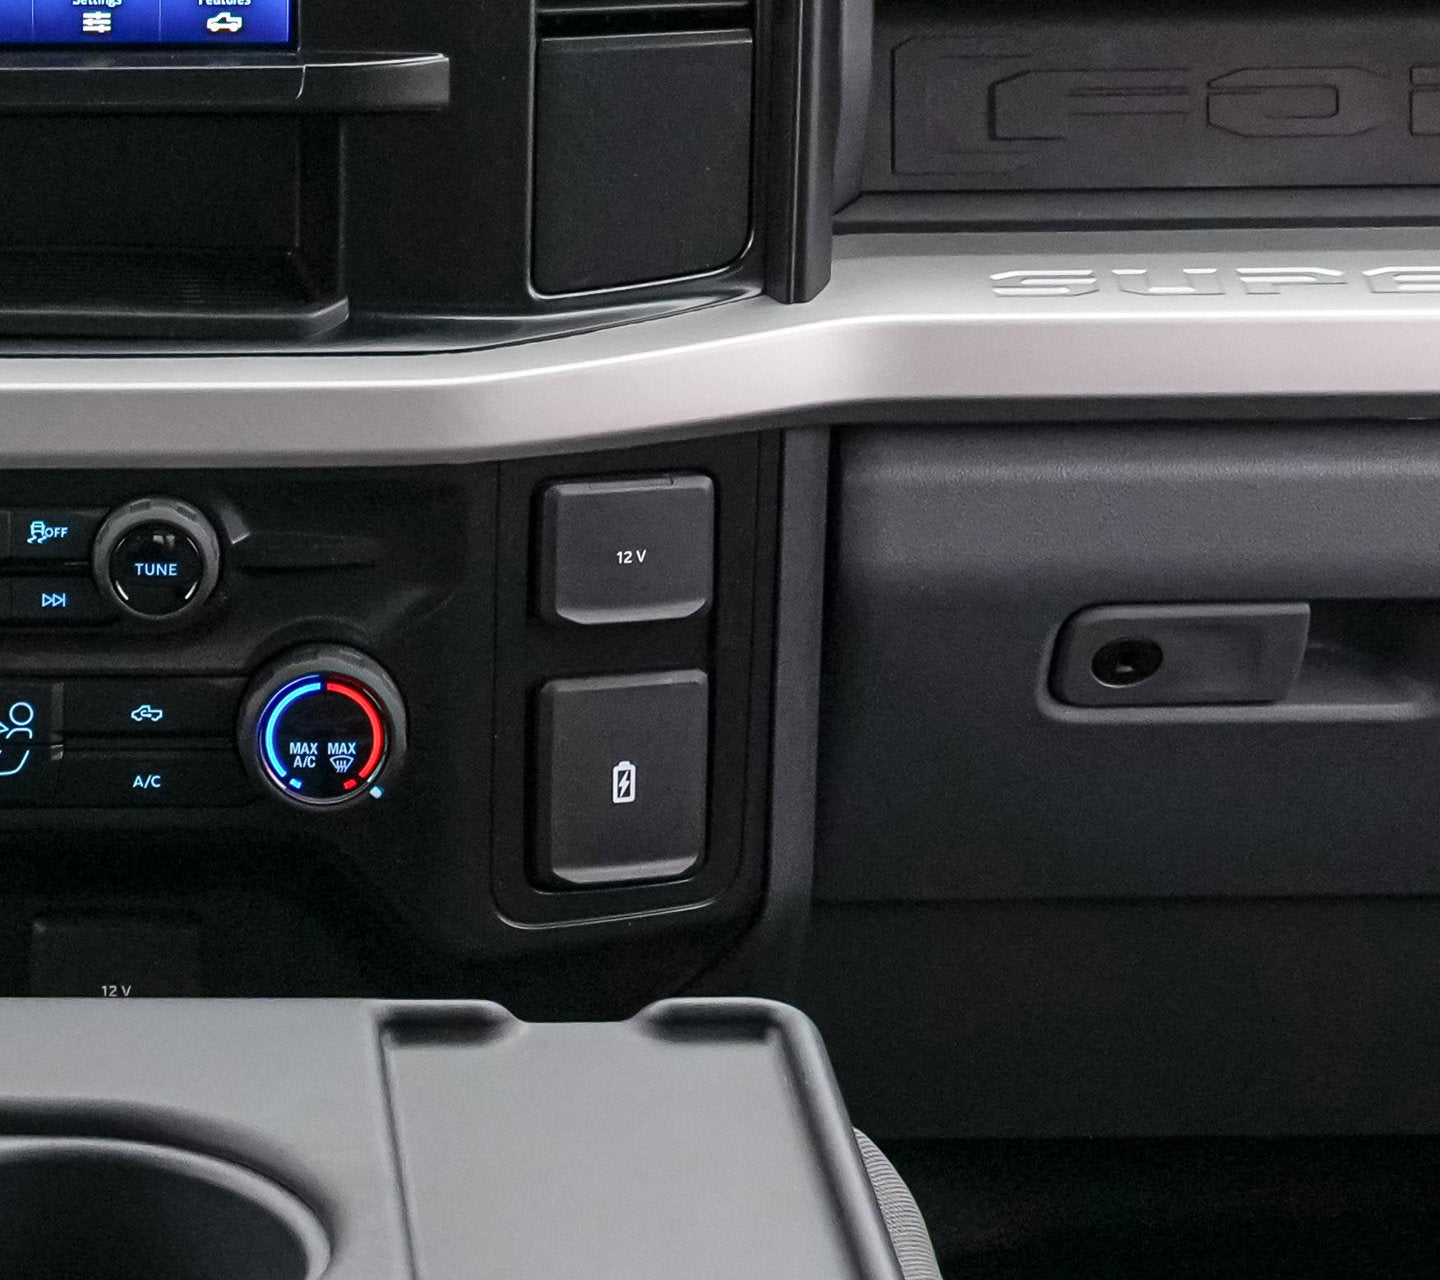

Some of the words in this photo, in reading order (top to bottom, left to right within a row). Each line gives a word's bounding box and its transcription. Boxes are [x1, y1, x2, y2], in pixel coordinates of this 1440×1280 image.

[44, 525, 68, 538] OFF
[616, 549, 632, 564] 12
[633, 549, 647, 564] V
[135, 563, 178, 577] TUNE
[290, 742, 319, 756] MAX
[327, 742, 357, 756] MAX
[293, 755, 316, 770] A/C
[133, 774, 161, 789] A/C
[101, 985, 118, 997] 12
[119, 985, 131, 997] V
